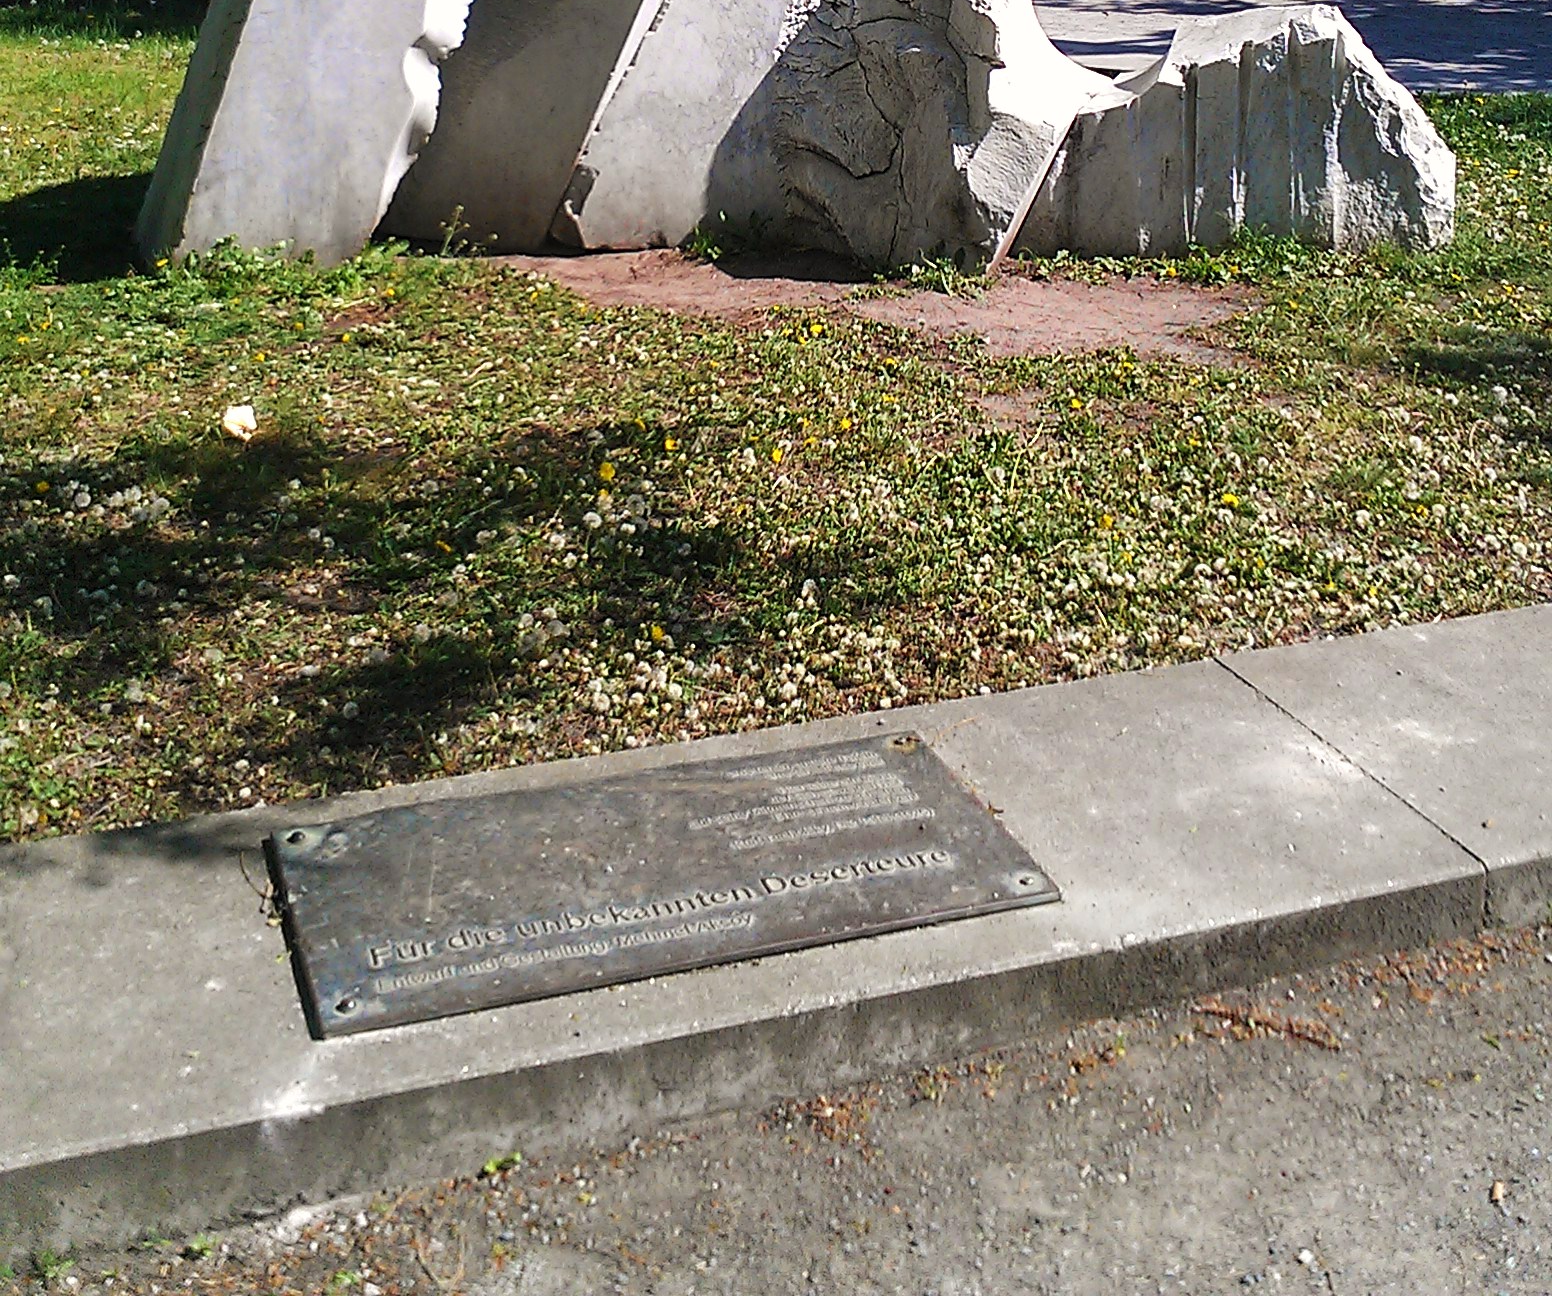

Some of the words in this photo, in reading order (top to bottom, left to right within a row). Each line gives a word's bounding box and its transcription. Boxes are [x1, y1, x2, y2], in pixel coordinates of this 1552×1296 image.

[367, 939, 435, 970] Für
[446, 926, 507, 952] die
[515, 886, 758, 940] unbekannten
[758, 849, 957, 897] Deserteure
